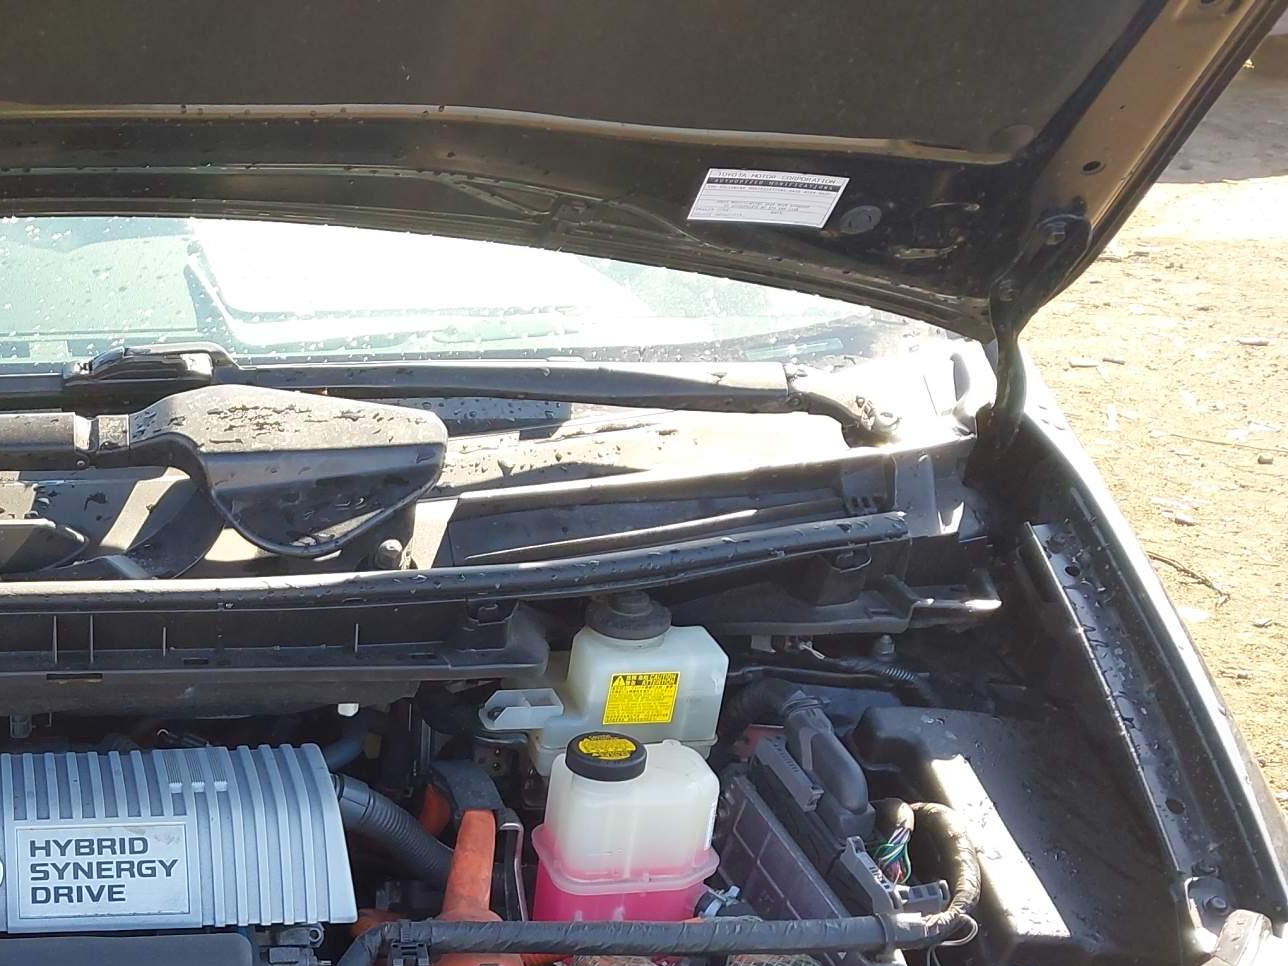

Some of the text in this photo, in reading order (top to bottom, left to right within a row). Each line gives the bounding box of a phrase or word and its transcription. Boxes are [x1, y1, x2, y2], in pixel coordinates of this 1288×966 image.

[781, 175, 836, 185] CORPORATION
[29, 836, 150, 859] HYBRID
[30, 858, 179, 881] SYNERGY
[30, 883, 127, 905] DRIVE
